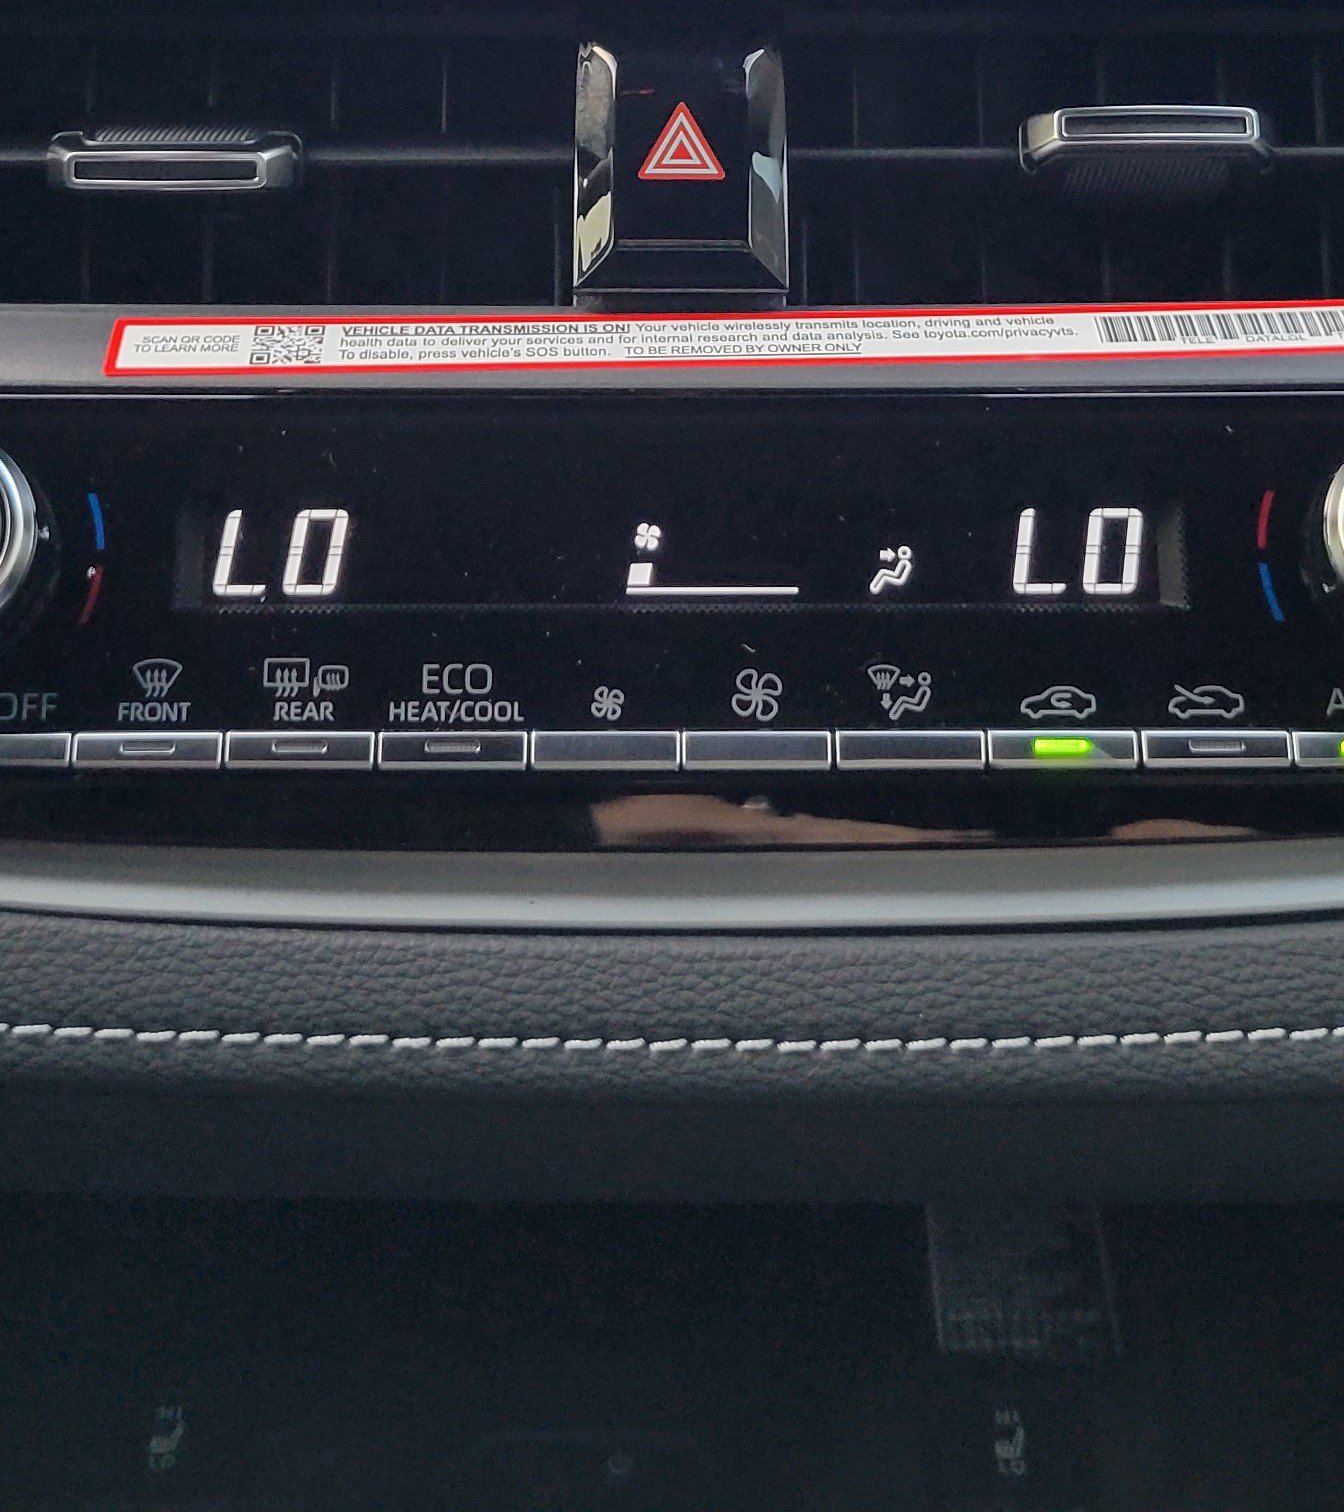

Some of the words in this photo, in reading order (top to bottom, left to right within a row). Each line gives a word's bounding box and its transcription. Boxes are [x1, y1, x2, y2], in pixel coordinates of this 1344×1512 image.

[342, 325, 411, 336] VEHICLE
[415, 325, 455, 336] DATA
[459, 324, 578, 335] TRANSMISSION
[583, 324, 603, 334] IS
[636, 323, 667, 332] Your
[671, 321, 720, 332] vehicle
[724, 320, 791, 331] wirelessly
[795, 320, 858, 329] transmits
[862, 318, 921, 330] location,
[925, 317, 970, 329] driving
[976, 317, 1001, 326] and
[1005, 316, 1054, 326] vehicle
[134, 343, 152, 353] TO
[154, 343, 197, 353] LEARN
[200, 343, 239, 352] MORE
[142, 334, 178, 344] SCAN
[203, 334, 241, 344] CODE
[340, 336, 382, 347] health
[387, 336, 417, 347] data
[422, 336, 436, 346] to
[441, 335, 488, 346] deliver
[492, 336, 523, 349] your
[527, 334, 584, 345] services
[588, 334, 614, 344] and
[618, 334, 637, 344] for
[641, 333, 693, 343] internal
[698, 332, 758, 342] research
[762, 332, 788, 341] and
[792, 331, 822, 341] data
[827, 330, 888, 342] analysis.
[892, 329, 920, 339] See
[339, 349, 357, 360] To
[360, 348, 414, 361] disable,
[418, 350, 457, 361] press
[461, 347, 522, 358] vehicle's
[526, 347, 559, 357] SOS
[563, 347, 612, 357] button.
[625, 346, 644, 355] TO
[648, 346, 667, 355] BE
[671, 345, 743, 355] REMOVED
[746, 344, 765, 354] BY
[768, 343, 822, 353] OWNER
[825, 342, 862, 352] ONLY
[421, 663, 494, 695] ECO
[117, 701, 192, 723] FRONT
[273, 701, 335, 723] REAR
[389, 700, 525, 724] HEAT/COOL
